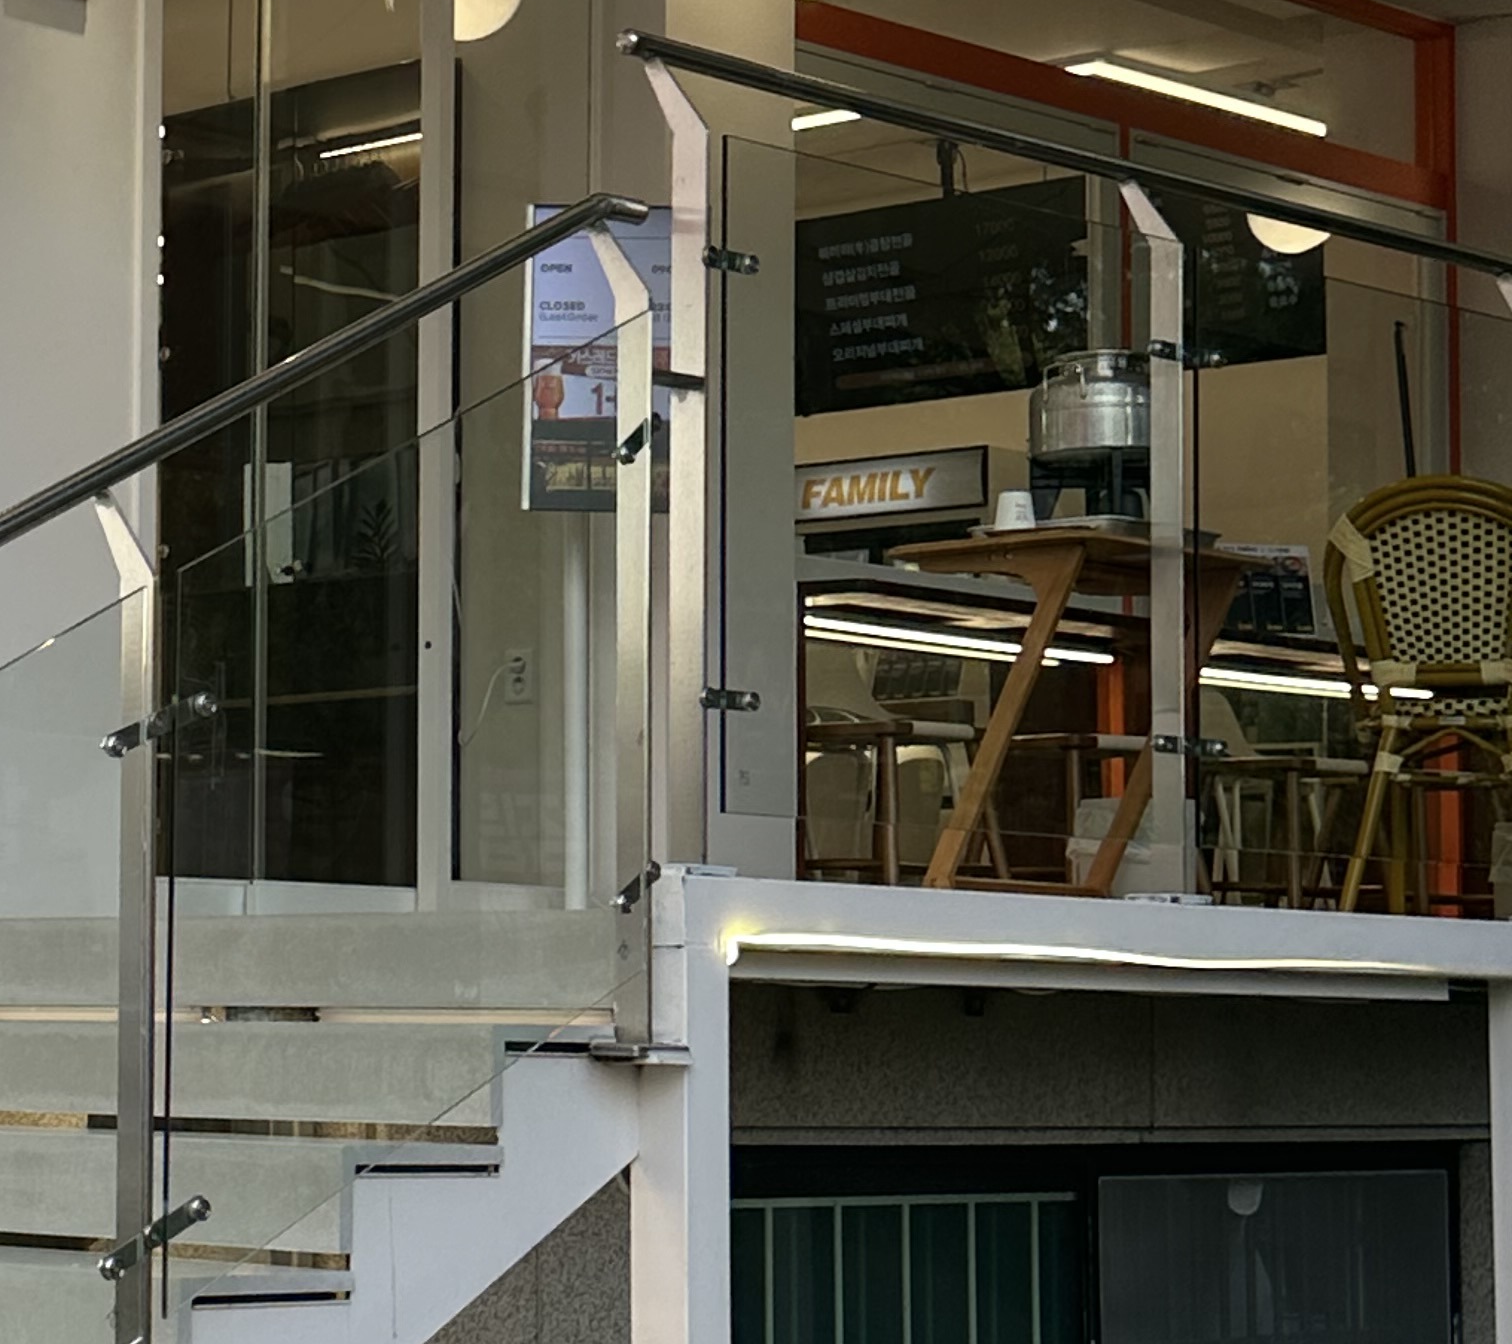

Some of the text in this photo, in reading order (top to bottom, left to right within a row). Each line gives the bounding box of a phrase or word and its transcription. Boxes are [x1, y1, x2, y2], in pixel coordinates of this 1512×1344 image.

[540, 263, 573, 273] OPEN
[539, 301, 585, 311] CLOSED
[801, 466, 936, 510] FAMILY
